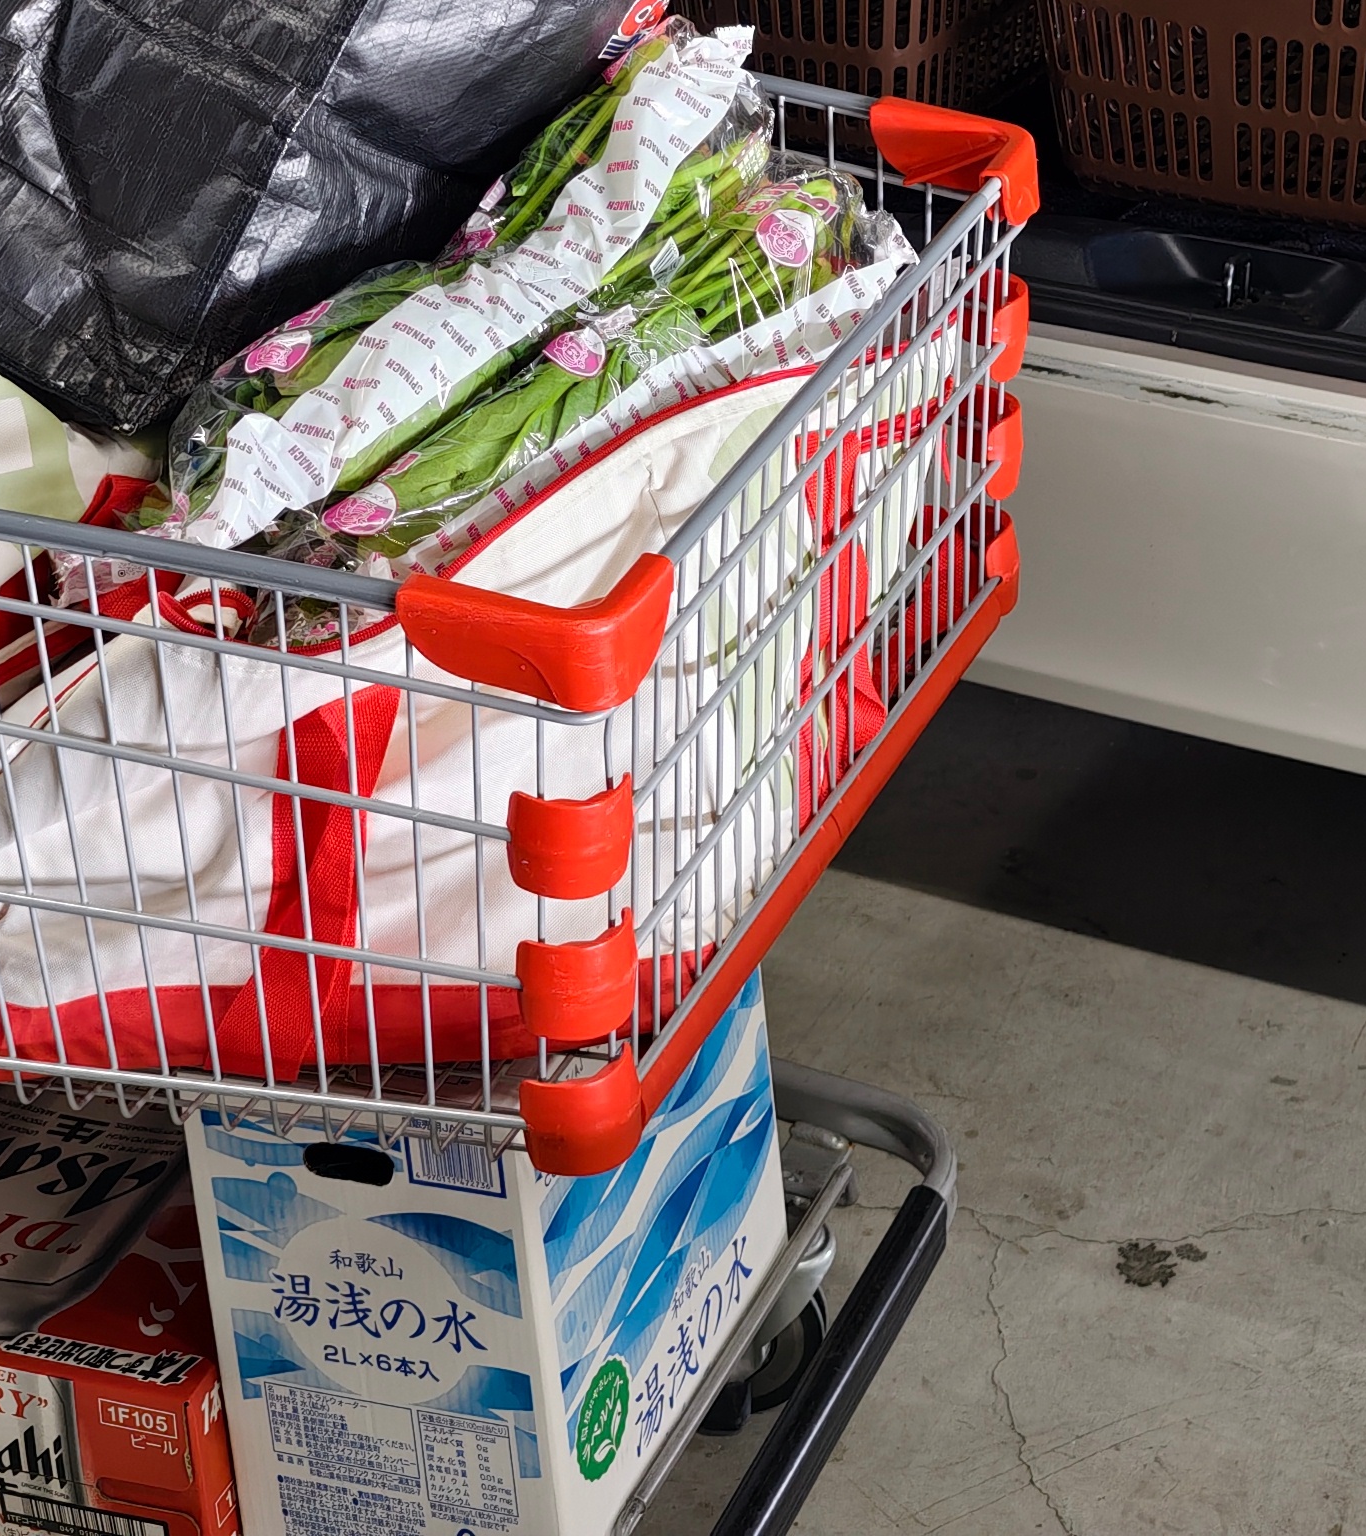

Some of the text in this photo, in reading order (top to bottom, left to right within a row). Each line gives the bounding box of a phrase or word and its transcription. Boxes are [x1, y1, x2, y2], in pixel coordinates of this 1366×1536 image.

[675, 88, 711, 118] SPINACH
[639, 136, 669, 166] SPINACH
[607, 160, 639, 173] SPINACH
[567, 203, 605, 226] SPINACH
[607, 201, 645, 212] SPINACH
[563, 239, 603, 264] SPINACH
[486, 295, 526, 324] SPINACH
[392, 321, 436, 350] SPINACH
[440, 319, 477, 357] SPINACH
[385, 358, 423, 396] SPINACH
[292, 421, 335, 442] SPINACH
[287, 444, 325, 487] SPINACH
[45, 1112, 109, 1147] 生
[329, 1248, 404, 1280] 和歌山
[668, 1243, 713, 1318] 和歌山
[271, 1271, 488, 1354] 湯浅の水
[632, 1232, 756, 1458] 湯浅の水
[322, 1344, 439, 1382] 2L×6本入
[105, 1405, 170, 1433] 1F105
[127, 1434, 179, 1457] ビール
